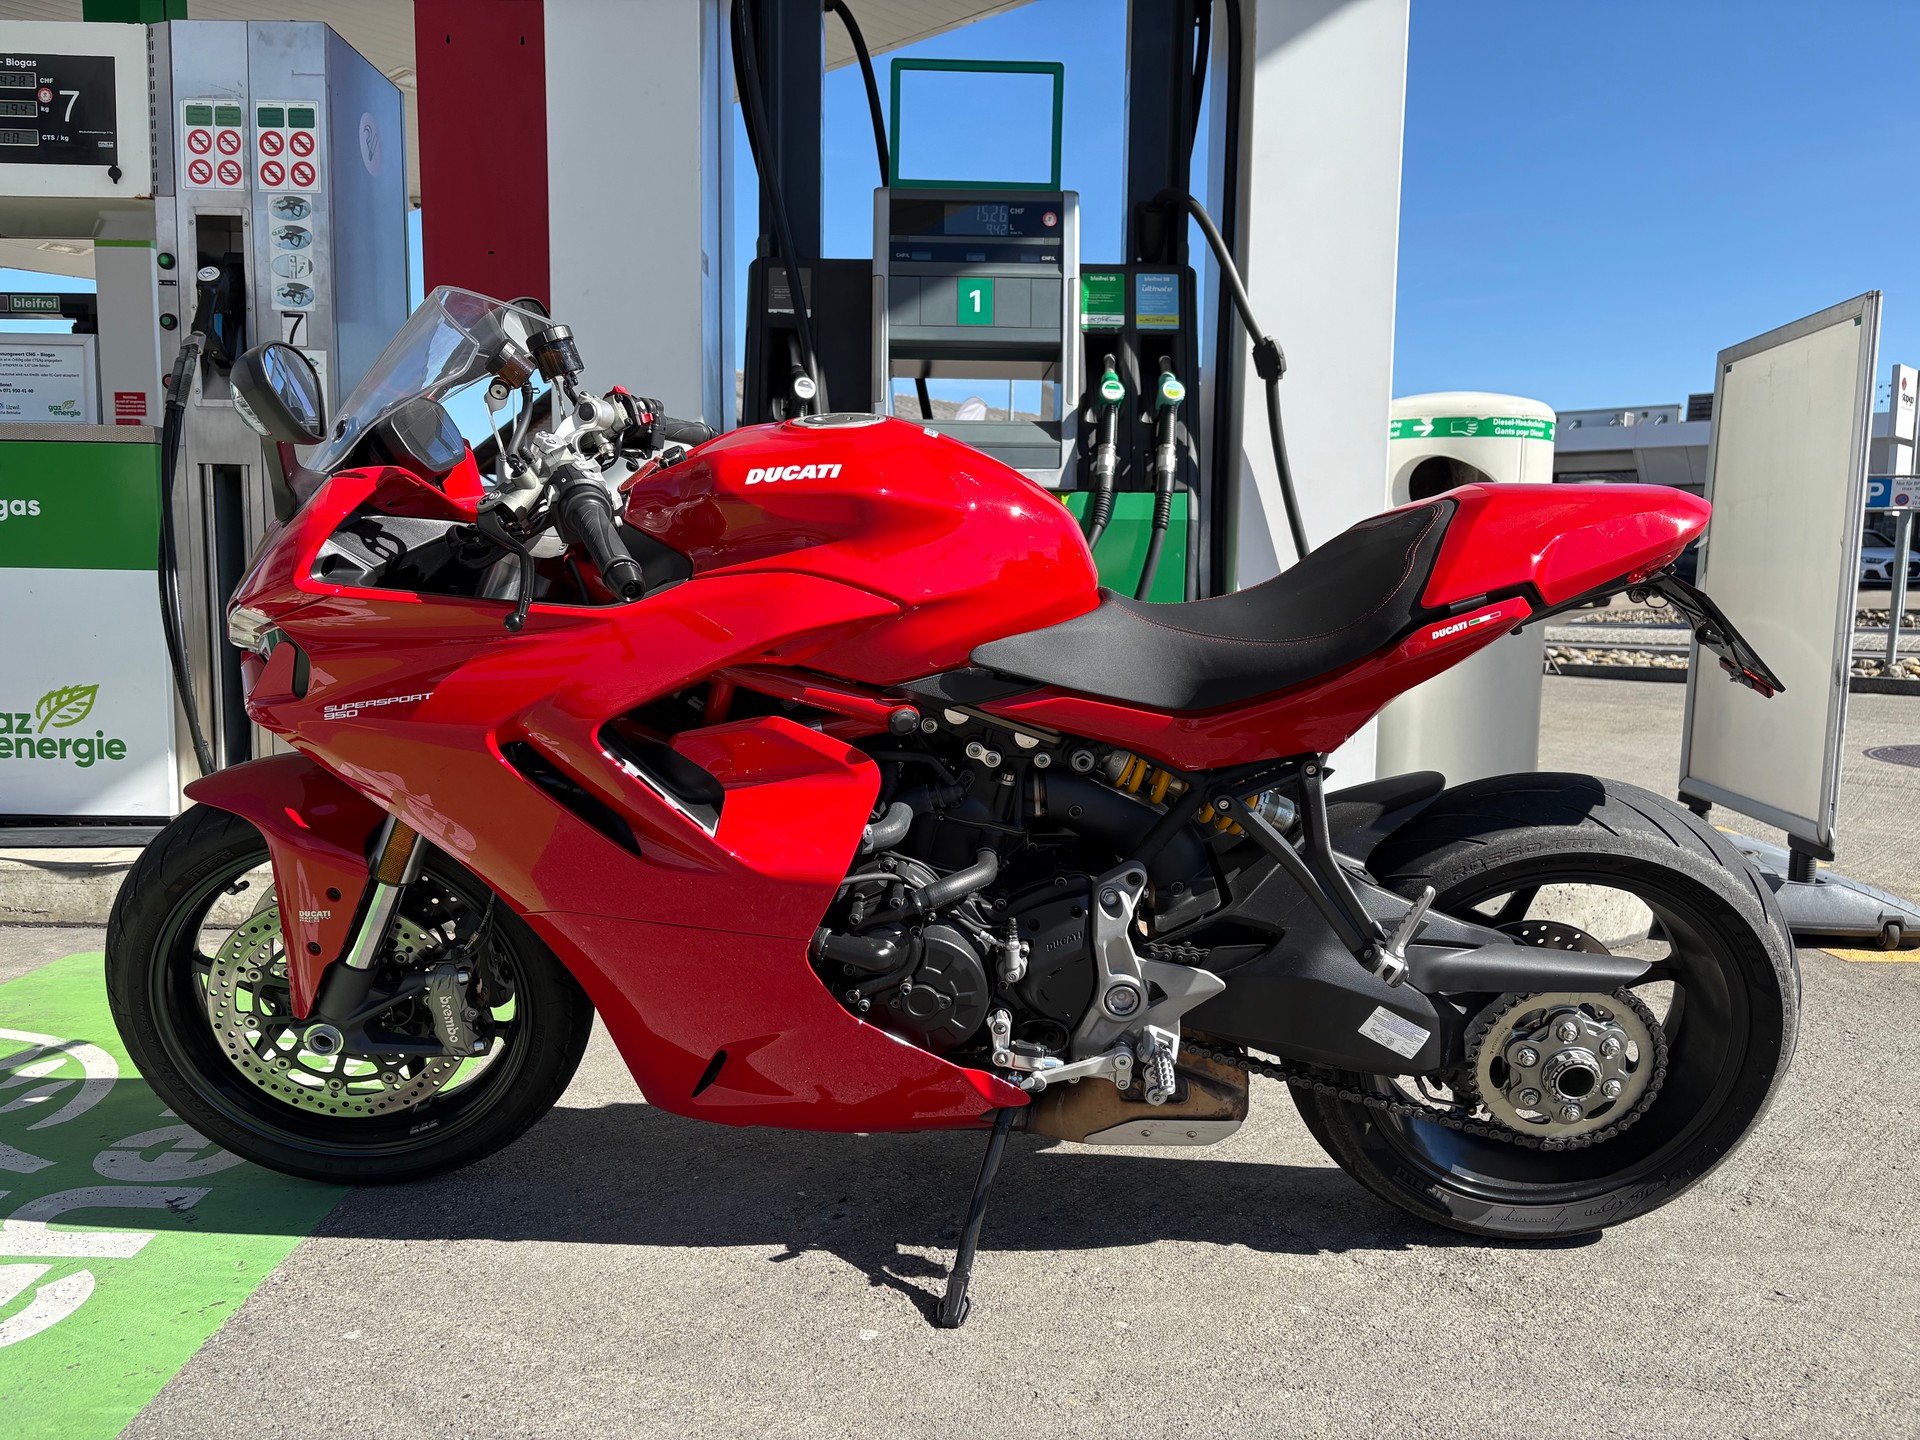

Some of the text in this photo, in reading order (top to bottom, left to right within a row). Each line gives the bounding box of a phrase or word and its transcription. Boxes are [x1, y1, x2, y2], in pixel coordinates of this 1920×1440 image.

[6, 58, 37, 68] Biogas
[59, 90, 80, 122] 7
[13, 298, 57, 309] bleifrei
[969, 289, 981, 313] 1
[283, 314, 304, 344] 7
[48, 405, 62, 413] gaz
[53, 409, 81, 418] energie
[1493, 418, 1546, 429] Diesel-Handschuhe
[1494, 427, 1515, 435] Gants
[745, 464, 842, 485] DUCATI
[1866, 482, 1885, 504] P
[1432, 621, 1468, 640] DUCATI
[324, 692, 434, 713] SUPERSPORT
[324, 708, 358, 721] 950
[1045, 931, 1083, 952] DUCATI
[440, 995, 459, 1043] brembo
